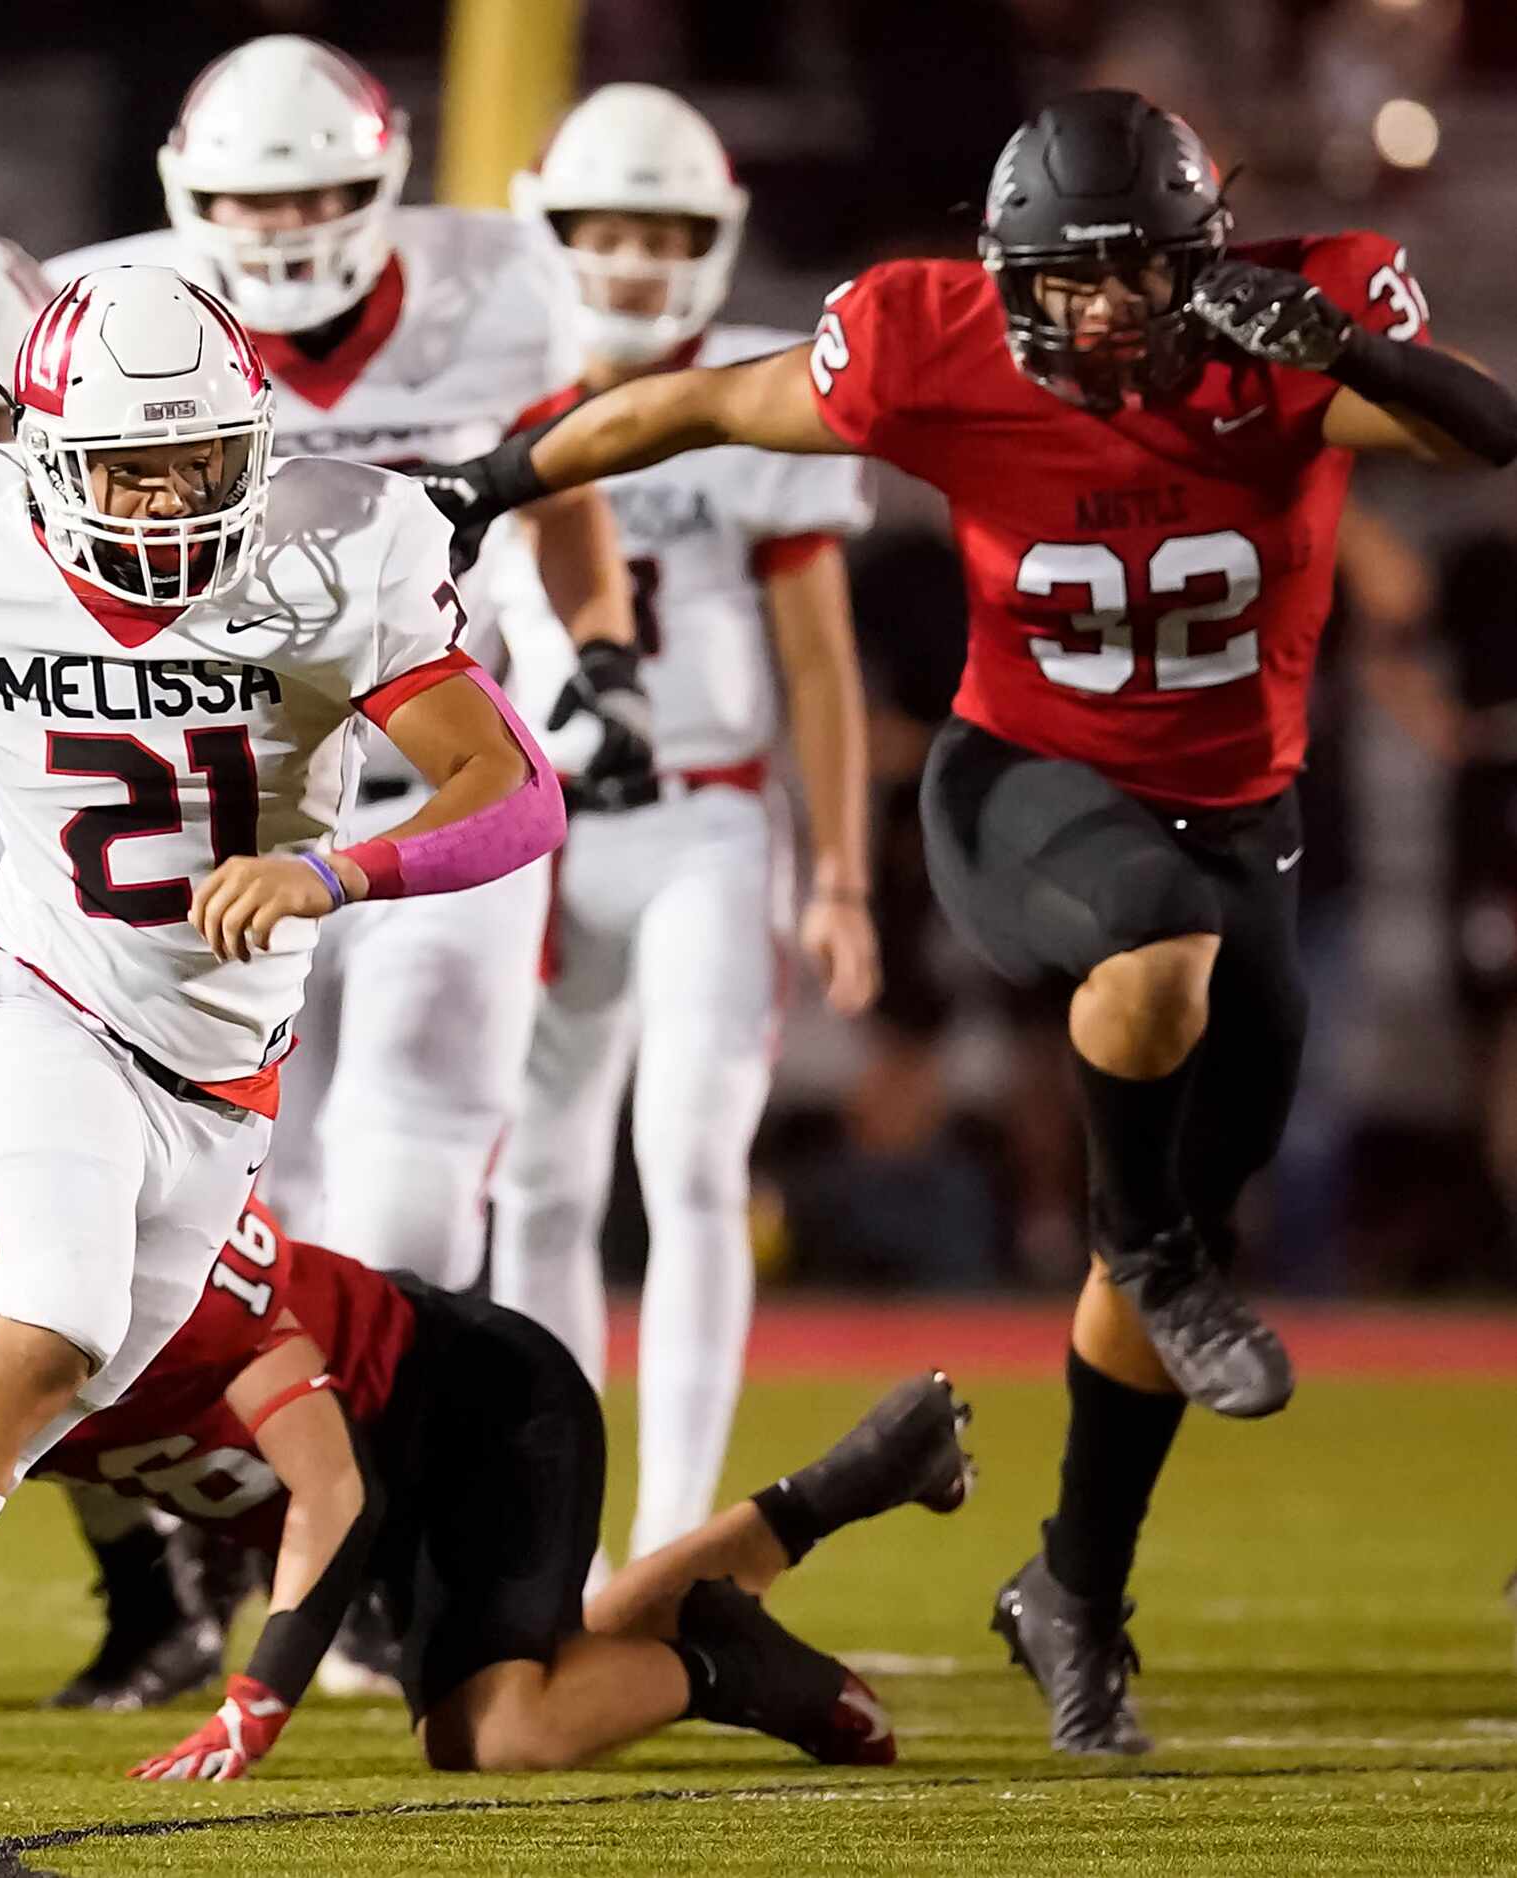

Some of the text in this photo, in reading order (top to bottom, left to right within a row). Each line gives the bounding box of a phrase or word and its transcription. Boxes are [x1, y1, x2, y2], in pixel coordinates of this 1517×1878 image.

[1016, 530, 1261, 694] 32
[45, 724, 259, 927] 21
[212, 1211, 277, 1317] 16
